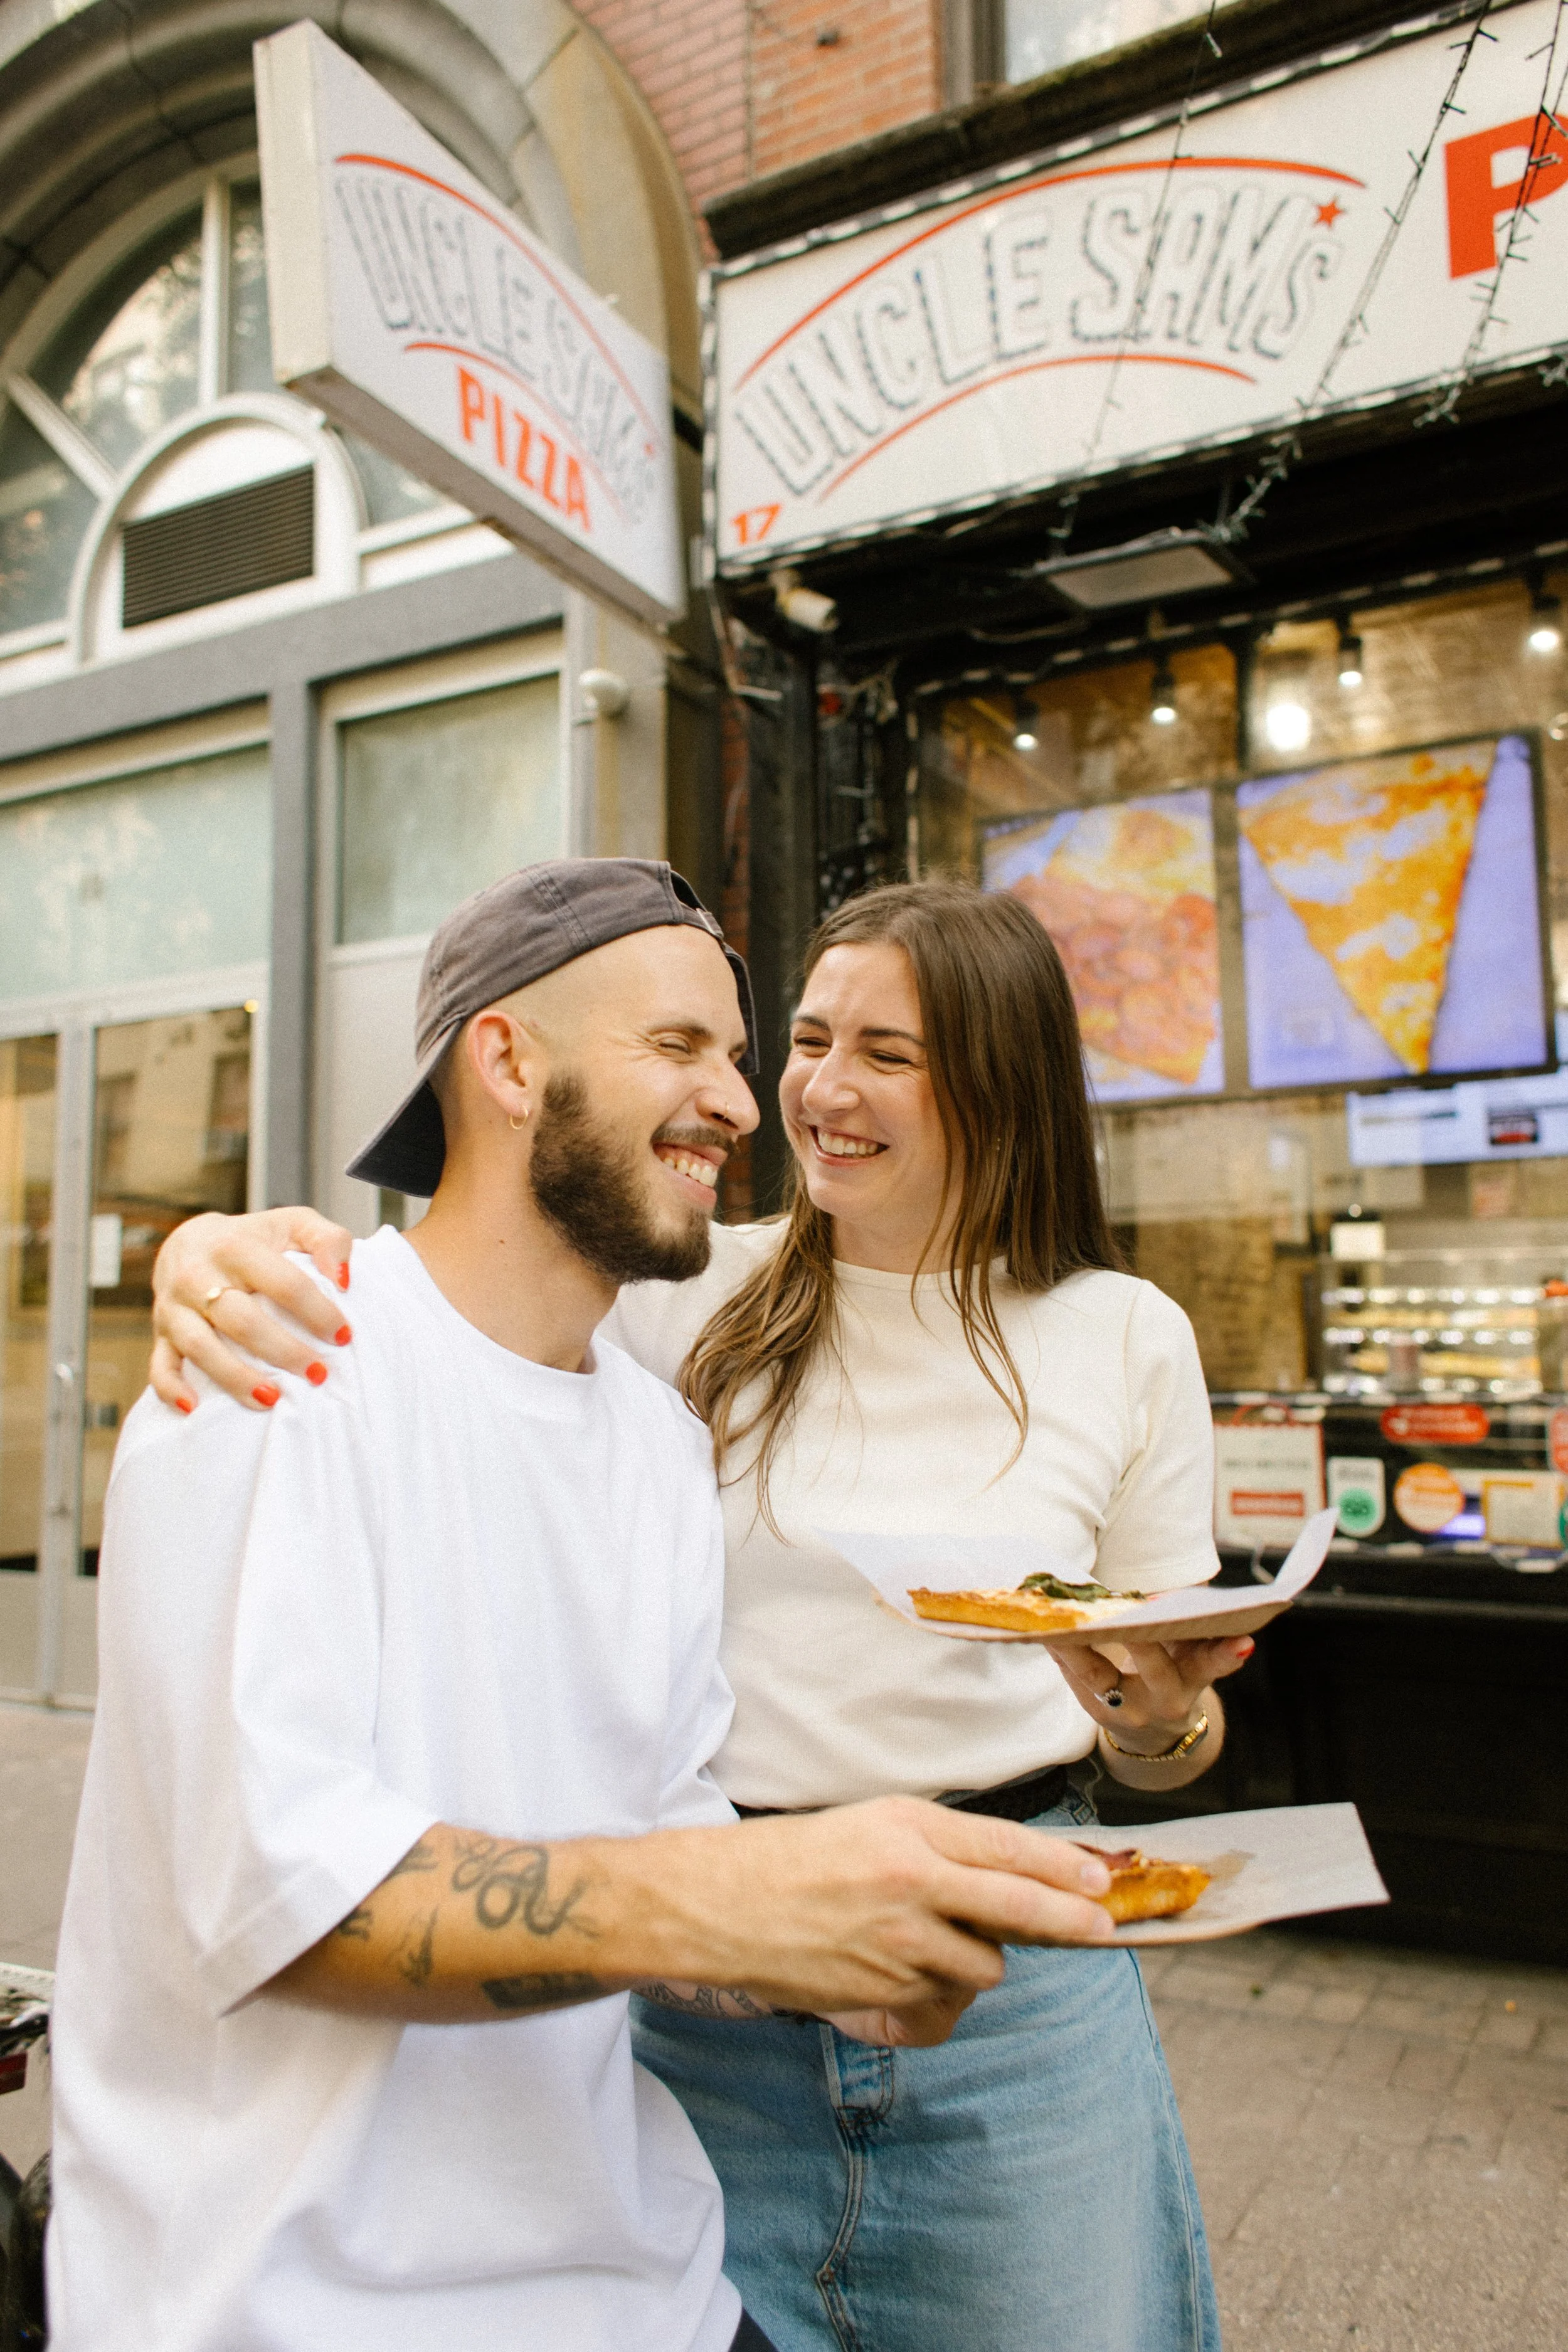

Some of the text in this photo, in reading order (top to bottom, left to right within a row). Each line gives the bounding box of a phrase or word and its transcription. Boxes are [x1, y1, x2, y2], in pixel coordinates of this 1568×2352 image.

[334, 177, 539, 381] UNCLE
[732, 209, 1052, 494] UNCLE
[456, 364, 591, 531] PIZZA
[731, 502, 781, 545] 17
